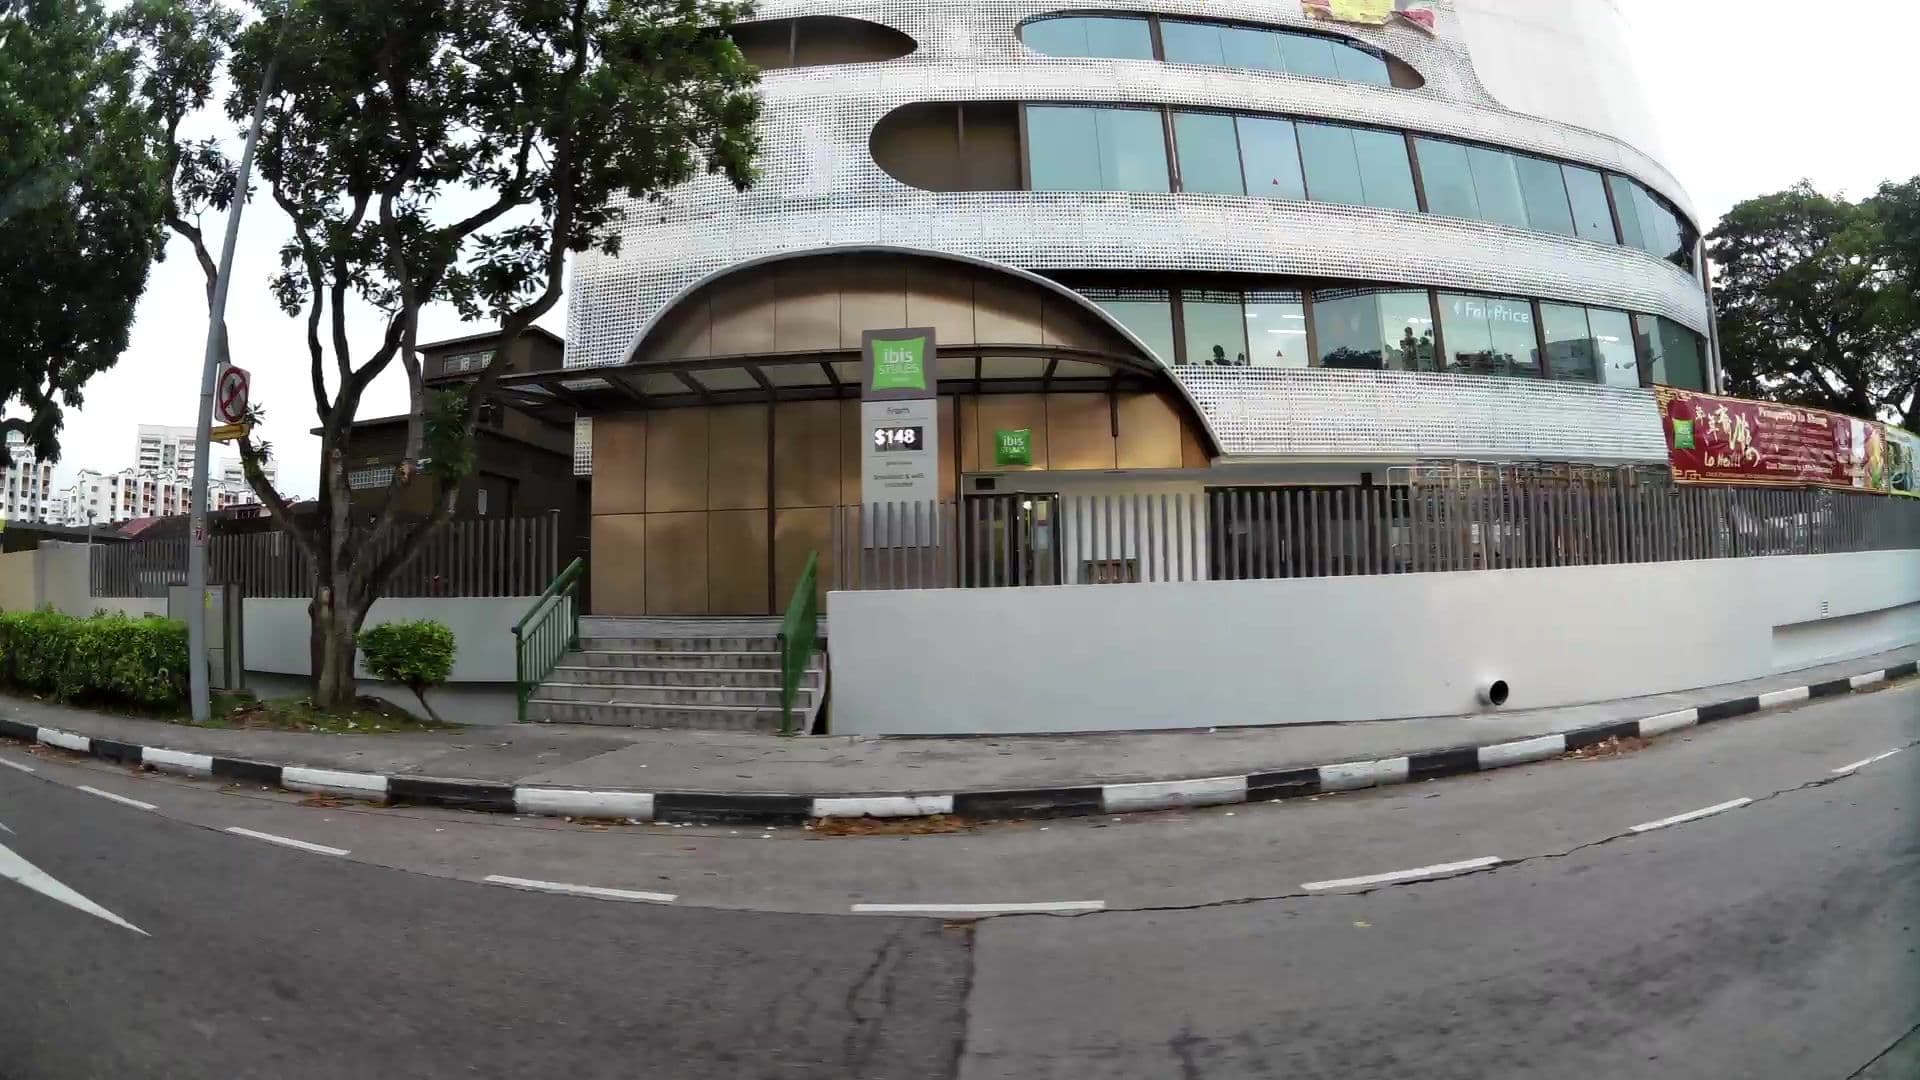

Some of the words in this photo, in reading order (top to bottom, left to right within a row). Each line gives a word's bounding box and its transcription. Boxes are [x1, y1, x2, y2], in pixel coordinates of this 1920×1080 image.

[1465, 302, 1529, 323] FairPrice
[882, 347, 913, 363] ibis
[874, 428, 916, 446] $148
[1003, 435, 1025, 447] ibis
